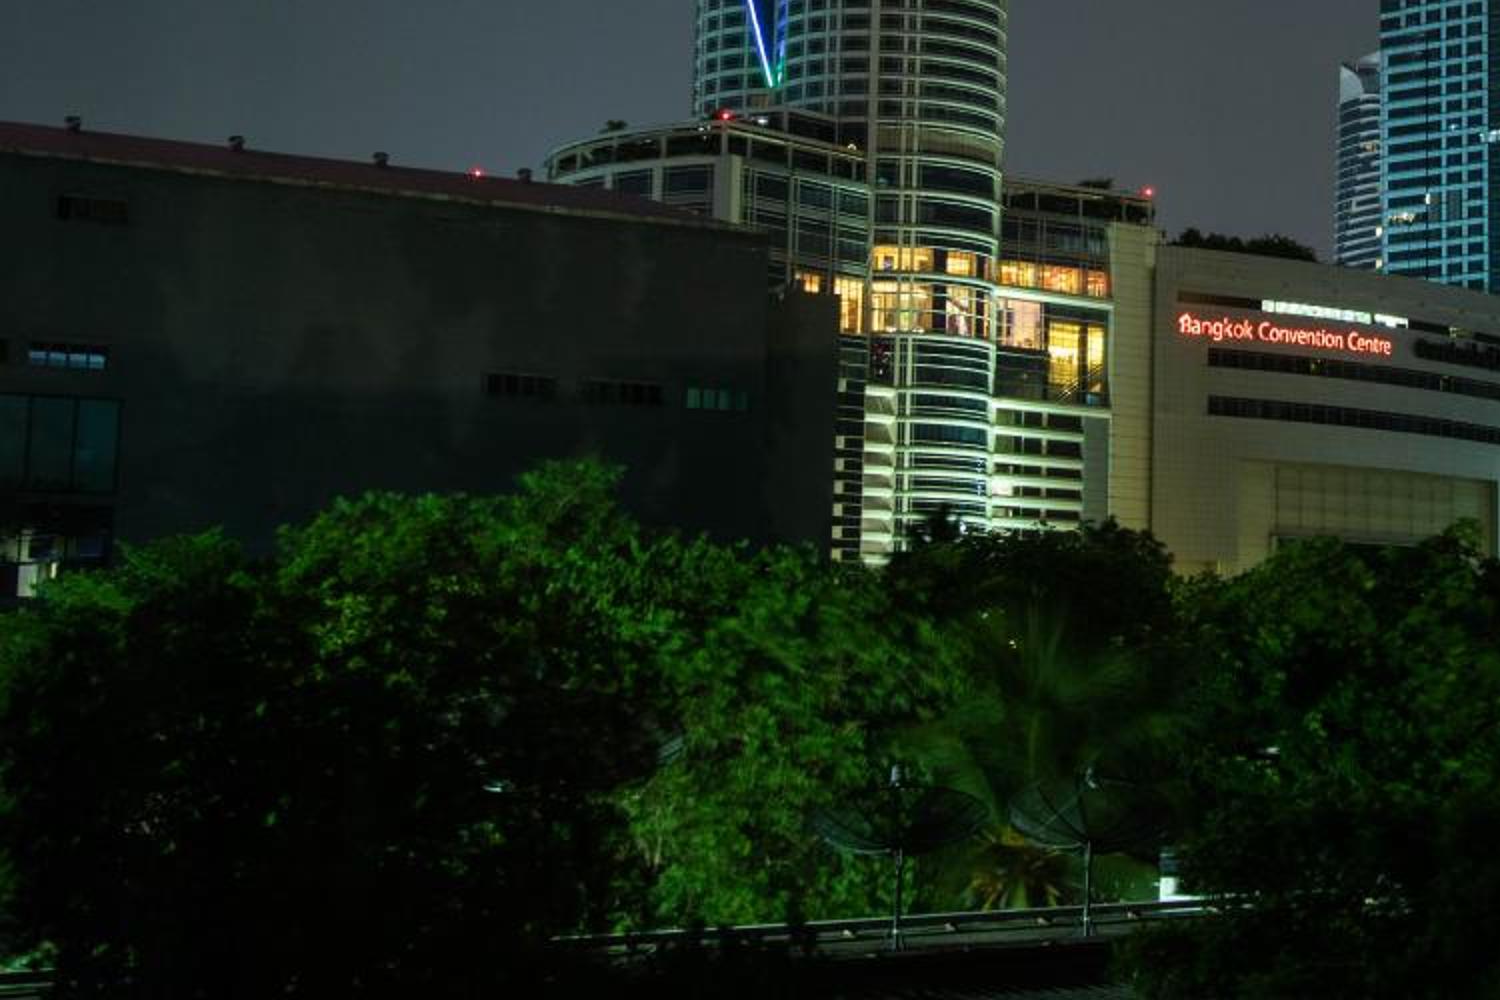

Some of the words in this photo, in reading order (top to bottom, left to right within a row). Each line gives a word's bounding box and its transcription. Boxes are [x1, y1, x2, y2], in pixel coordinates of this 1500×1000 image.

[1178, 313, 1253, 341] Bangkok
[1258, 321, 1344, 350] Convention
[1347, 332, 1393, 356] Centre
